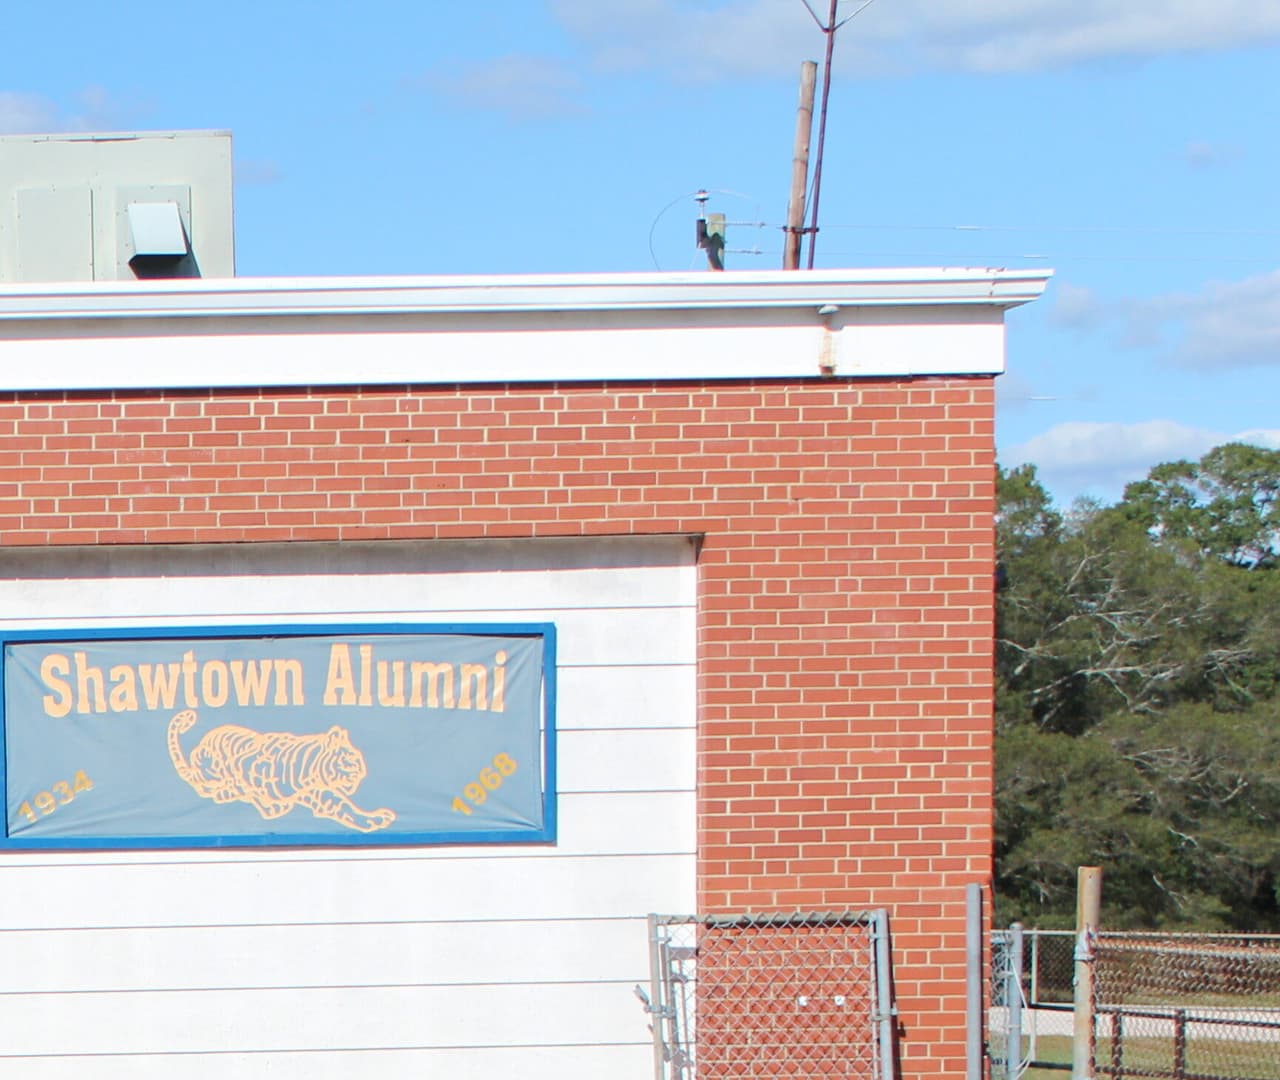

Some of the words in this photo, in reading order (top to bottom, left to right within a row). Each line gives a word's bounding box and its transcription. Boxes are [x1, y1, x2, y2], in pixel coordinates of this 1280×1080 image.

[40, 650, 304, 718] Shawtown
[323, 643, 507, 712] Alumni
[18, 769, 94, 824] 1934
[450, 752, 518, 816] 1968
